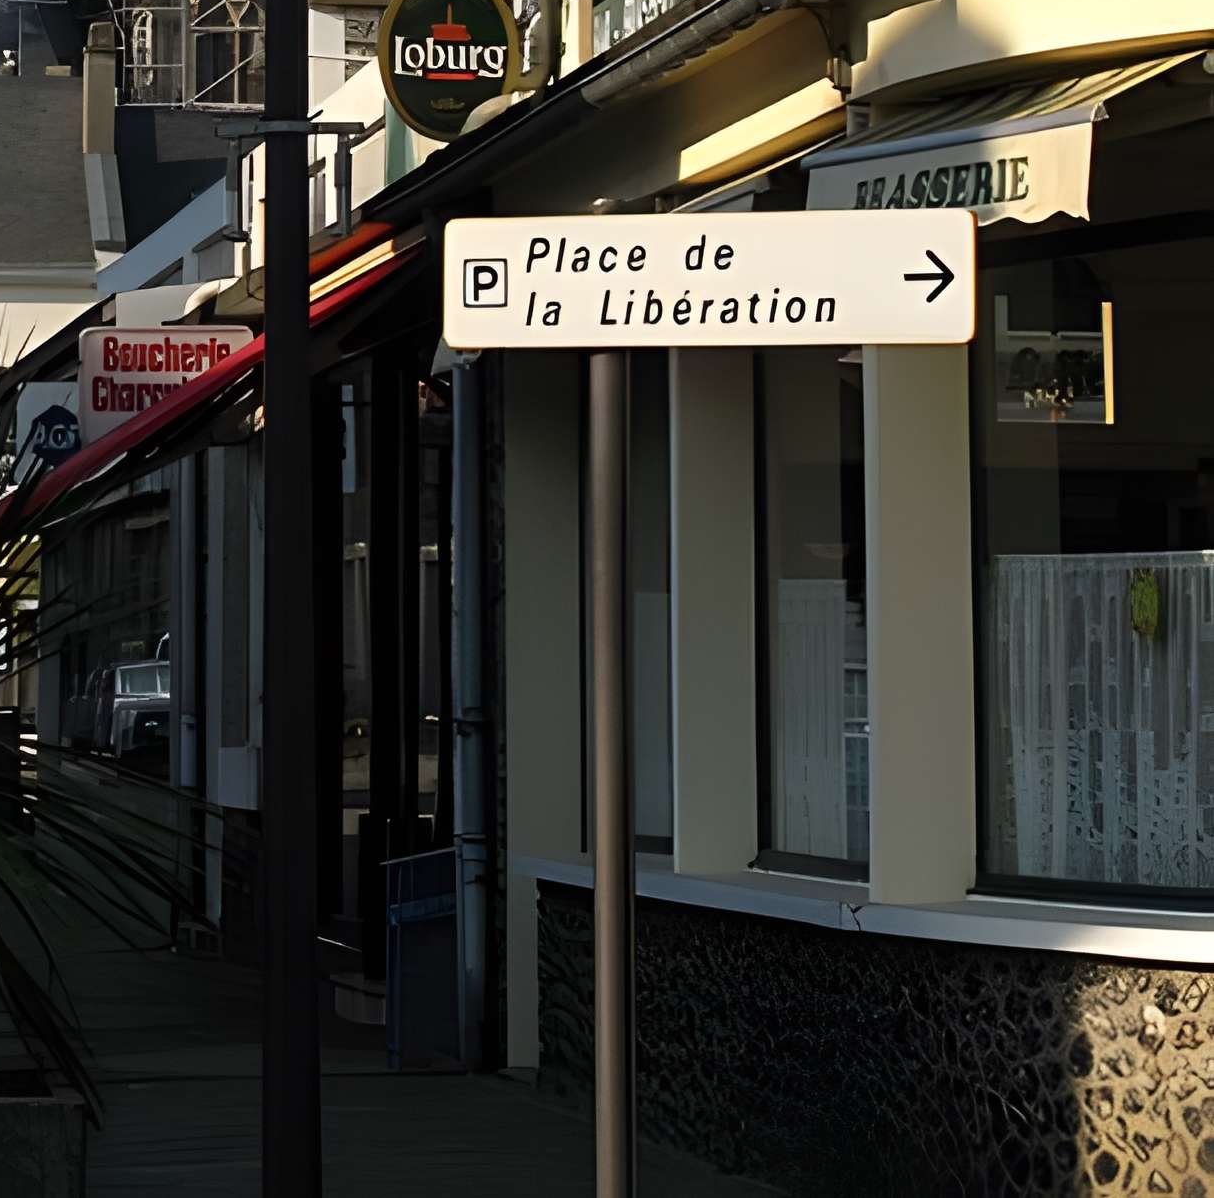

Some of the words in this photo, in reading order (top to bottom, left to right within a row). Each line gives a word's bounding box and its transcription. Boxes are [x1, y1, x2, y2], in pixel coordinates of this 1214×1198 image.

[394, 35, 508, 78] Loburg
[853, 156, 1029, 210] BRASSERIE
[526, 237, 647, 274] Place
[685, 234, 734, 271] de
[472, 265, 499, 302] P
[525, 291, 562, 327] la
[600, 287, 837, 326] Libération
